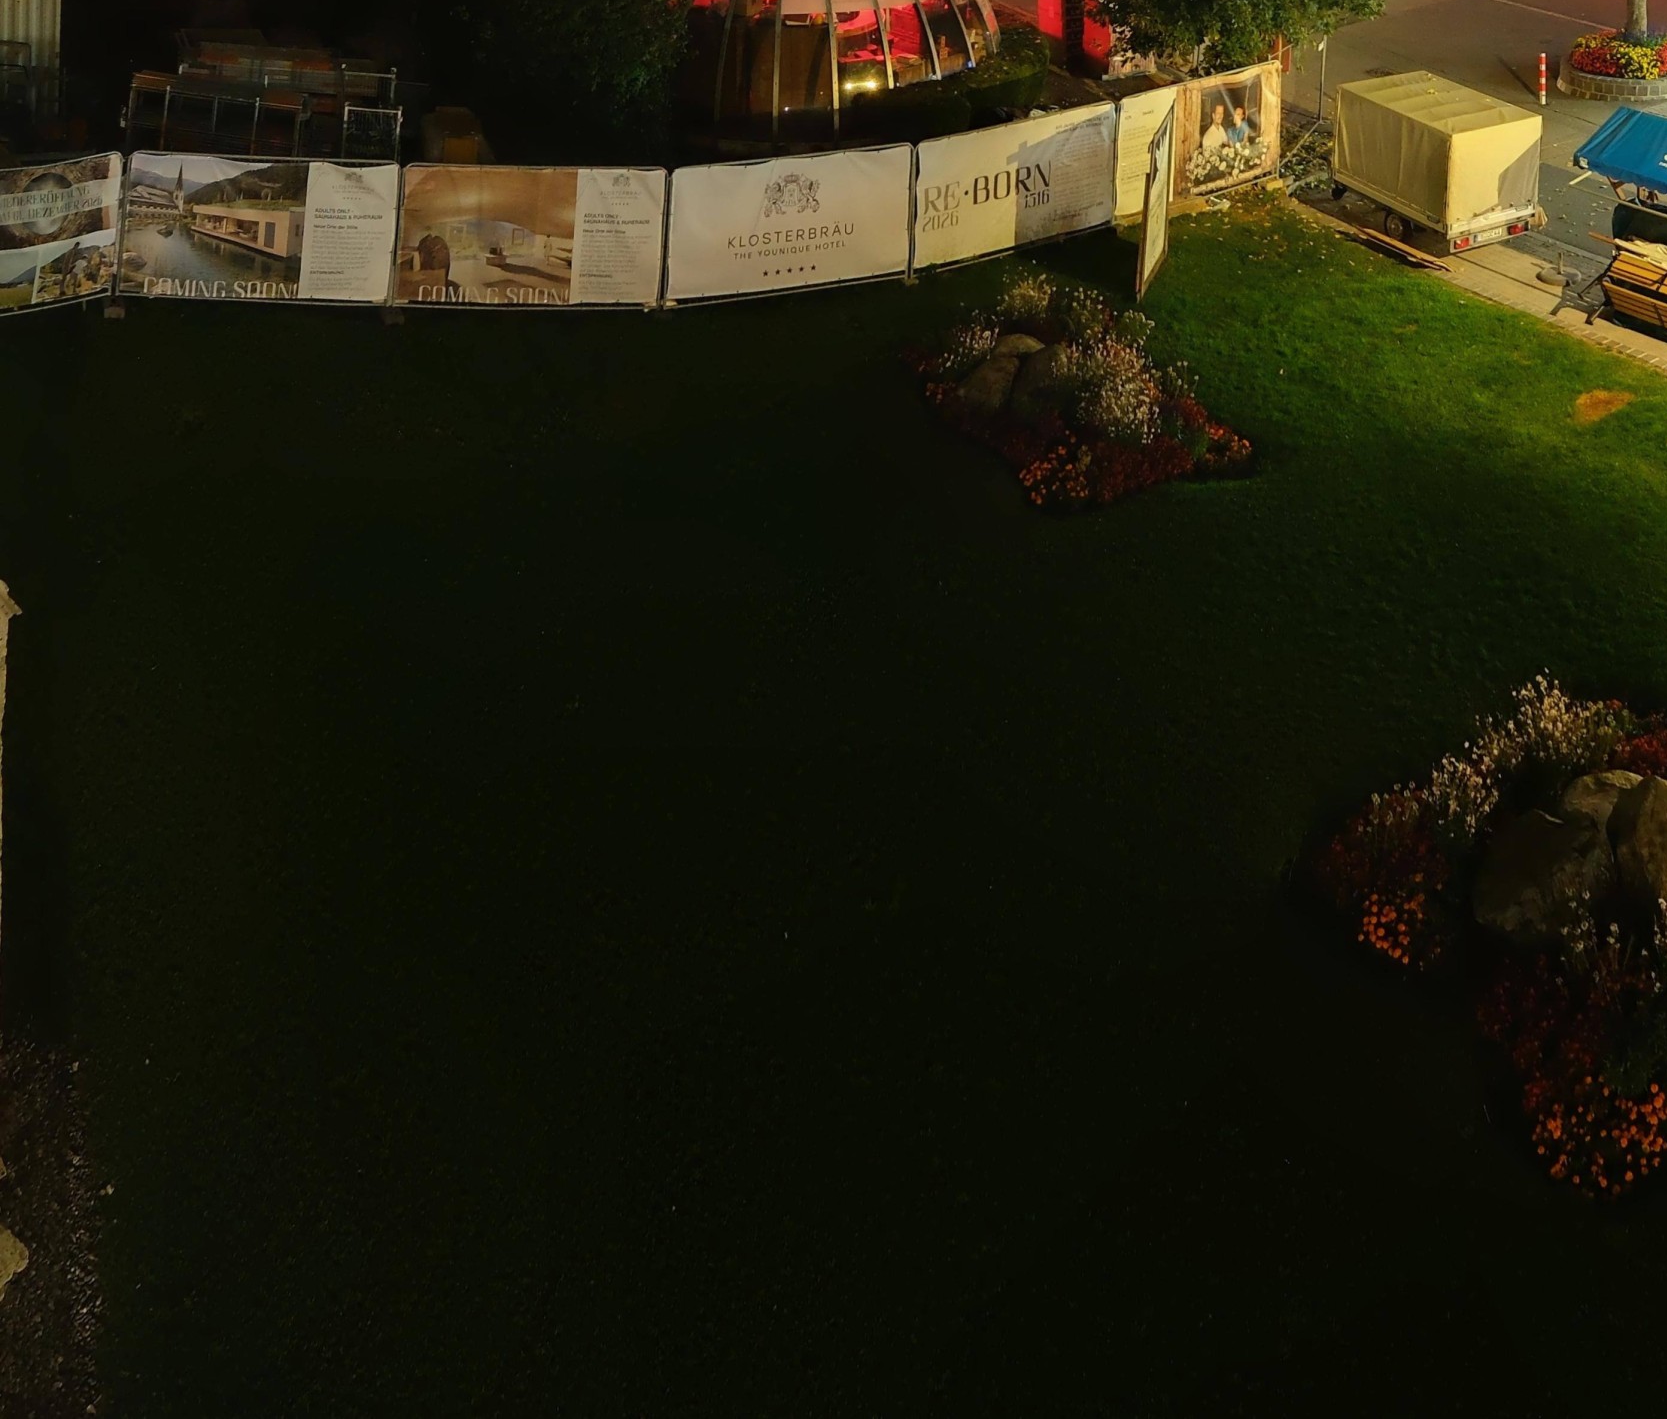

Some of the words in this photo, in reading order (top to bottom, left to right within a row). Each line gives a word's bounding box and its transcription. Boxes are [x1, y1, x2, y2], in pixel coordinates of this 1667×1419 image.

[1023, 191, 1051, 210] 1516
[922, 210, 960, 232] 2026
[727, 222, 856, 249] KLOSTERBRÄU
[734, 251, 753, 261] THE
[757, 245, 812, 258] YOUNIQUE
[815, 240, 847, 252] HOTEL
[142, 276, 226, 299] COMING
[232, 280, 300, 299] SOON!
[418, 284, 499, 303] COMING
[506, 286, 570, 304] SOON!
